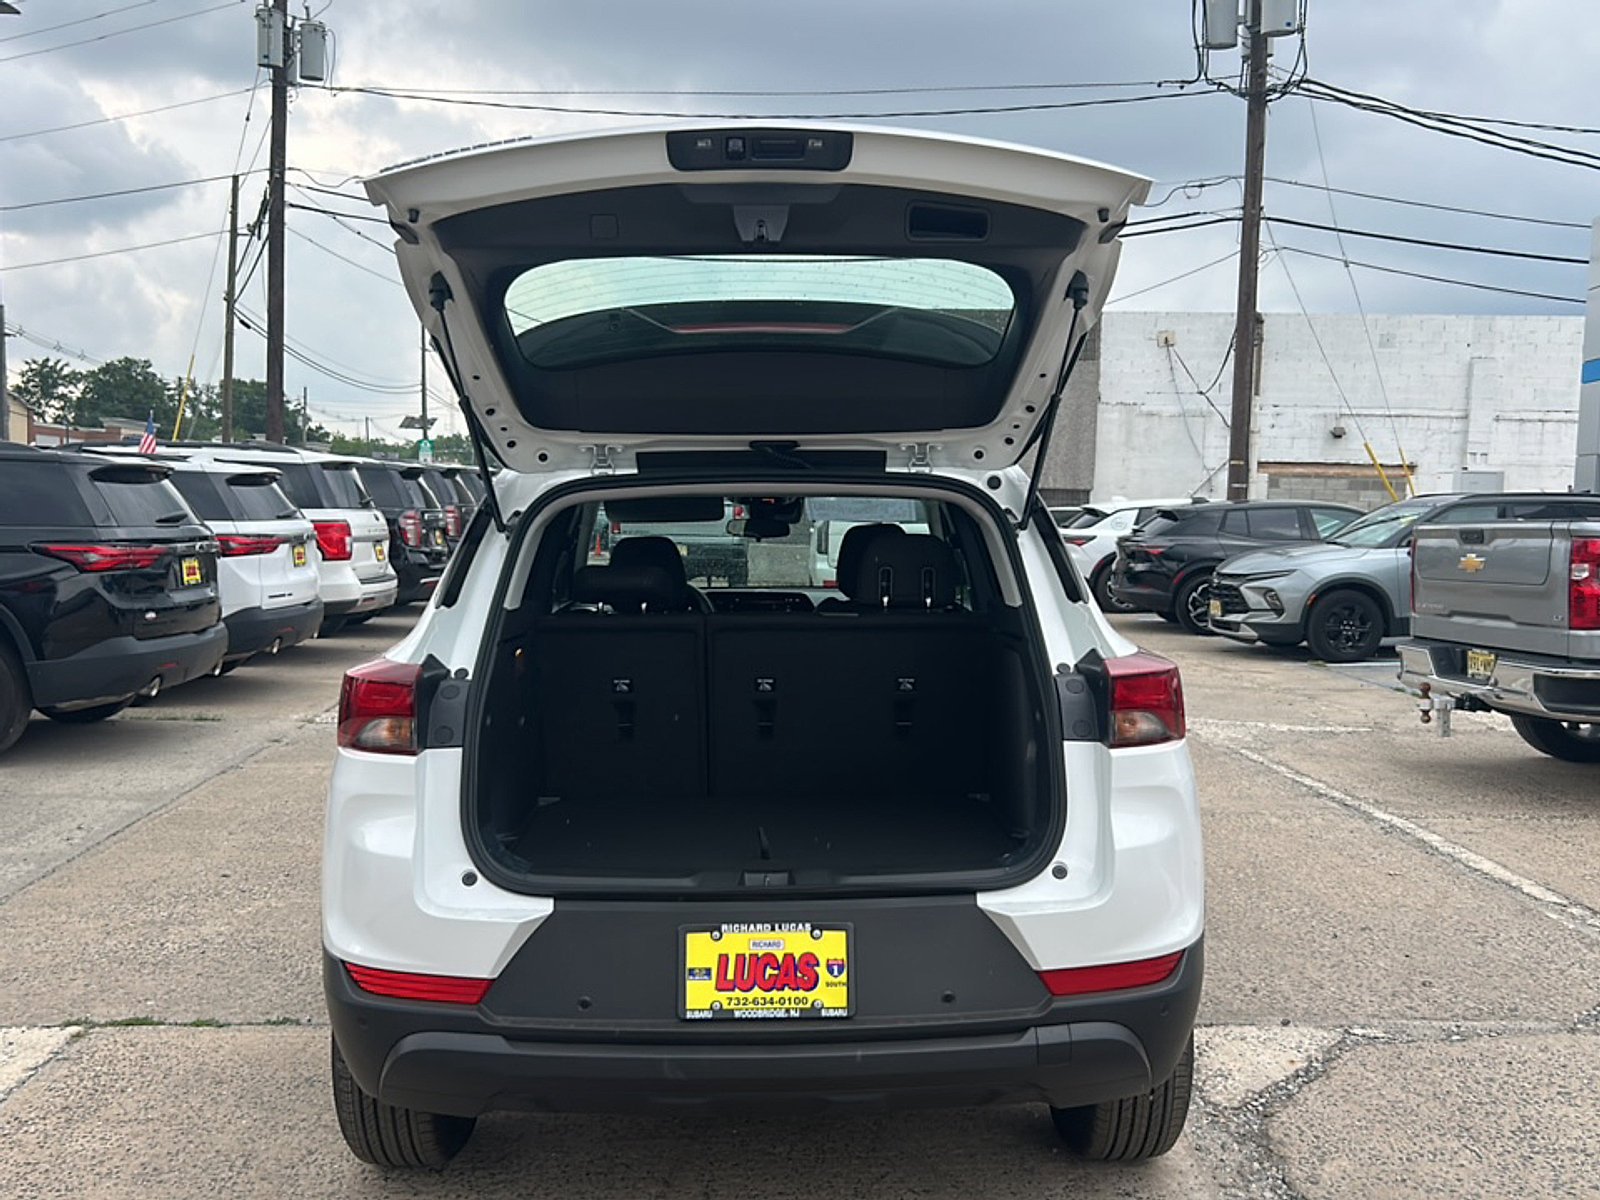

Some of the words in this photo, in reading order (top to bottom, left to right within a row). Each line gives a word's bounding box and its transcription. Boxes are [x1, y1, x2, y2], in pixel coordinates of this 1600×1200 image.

[721, 923, 771, 933] RICHARD
[775, 922, 812, 931] LUCAS
[751, 940, 782, 949] RICHARD
[716, 952, 819, 992] LUCAS
[726, 997, 809, 1006] 732-634-0100
